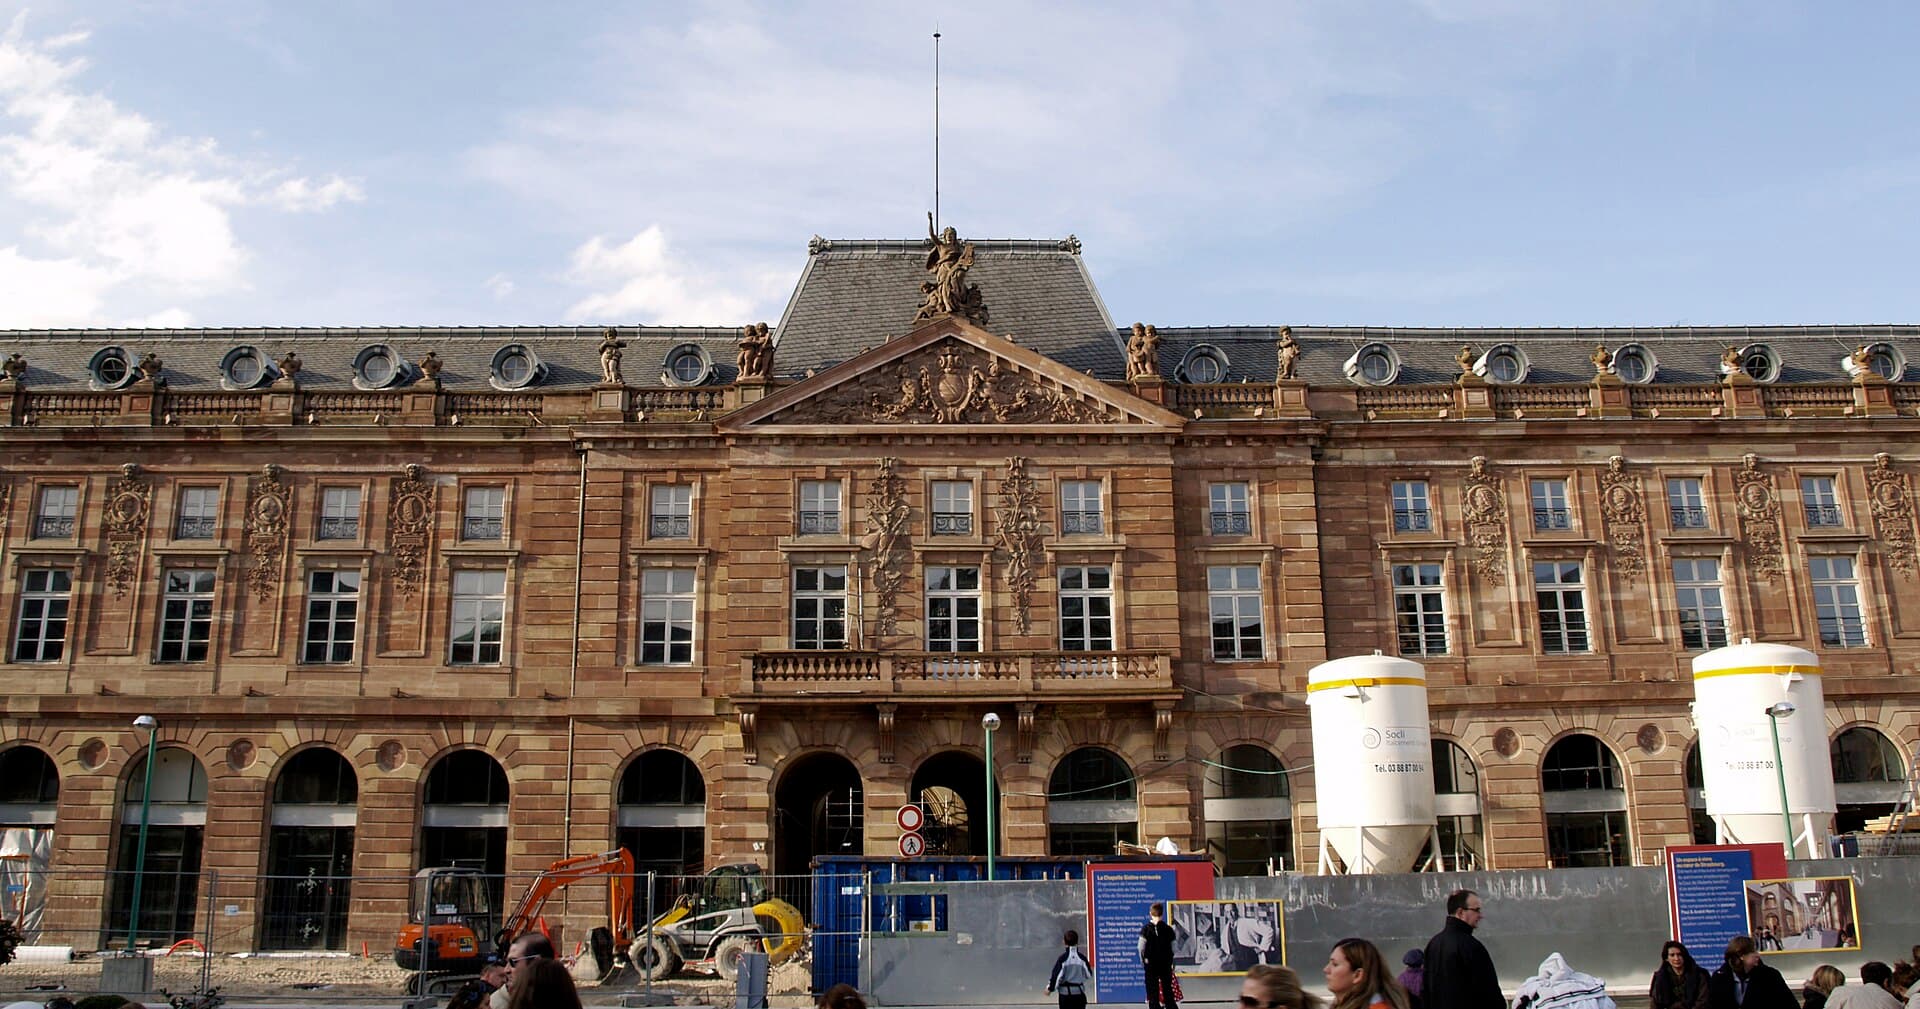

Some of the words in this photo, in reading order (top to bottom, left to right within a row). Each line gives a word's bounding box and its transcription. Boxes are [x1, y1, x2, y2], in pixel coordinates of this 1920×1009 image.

[1385, 730, 1405, 739] Socli
[1375, 764, 1387, 773] Tel.
[1388, 764, 1396, 773] 03
